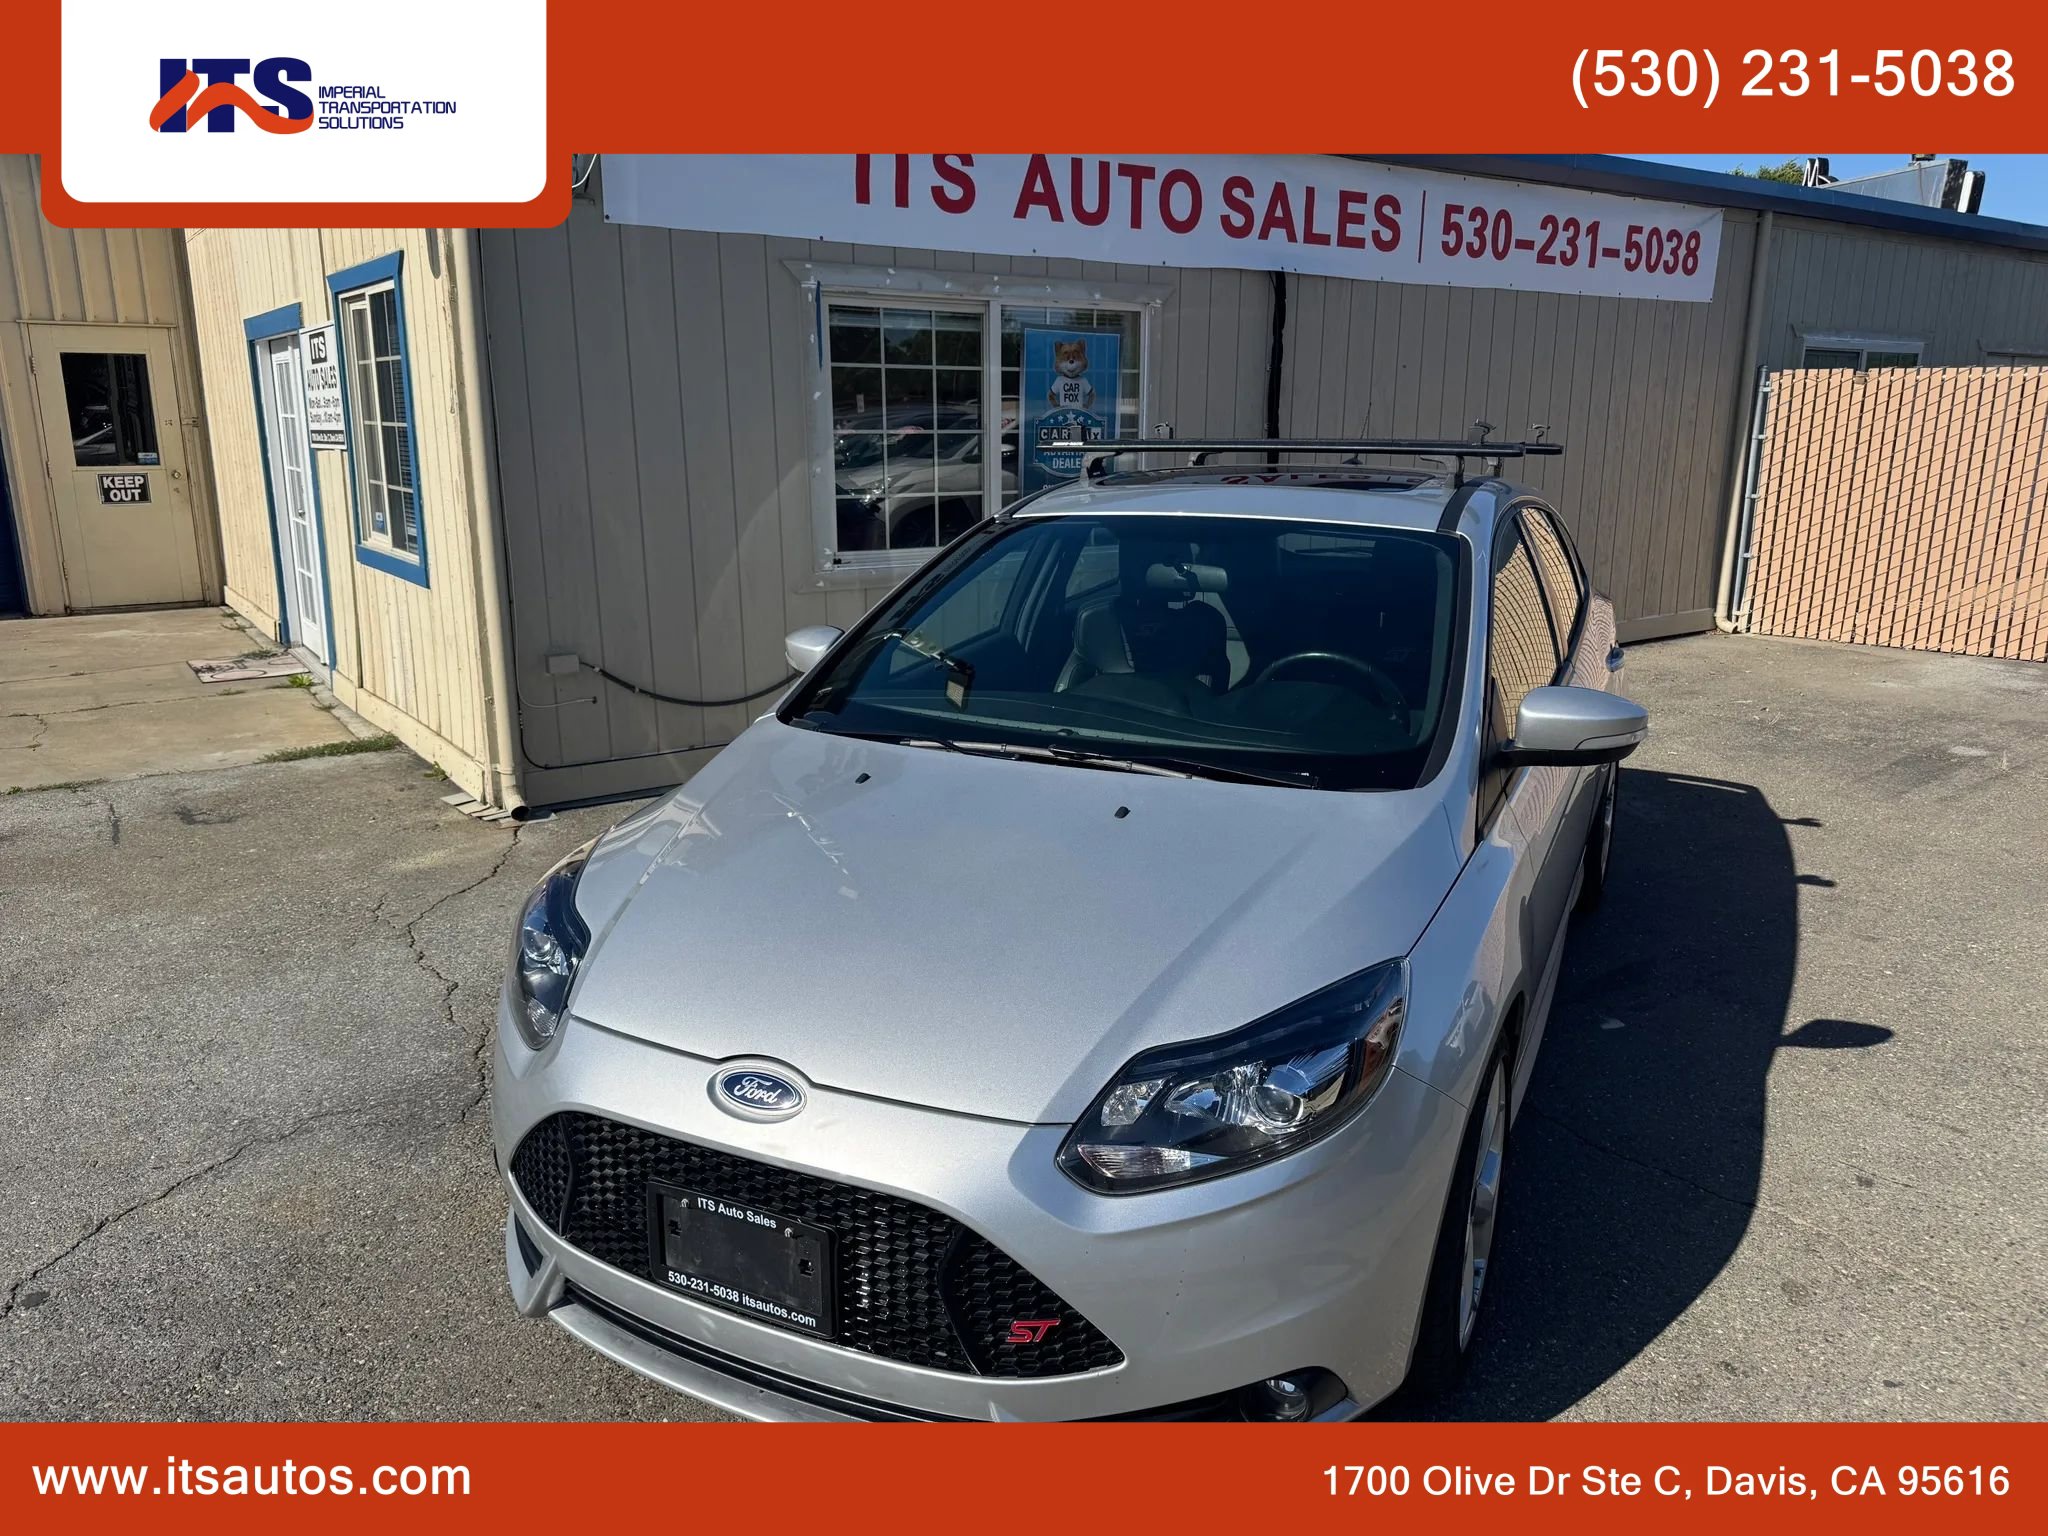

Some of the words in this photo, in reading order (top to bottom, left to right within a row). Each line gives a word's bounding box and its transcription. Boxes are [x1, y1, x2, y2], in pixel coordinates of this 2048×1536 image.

[1013, 154, 1203, 235] AUTO
[1219, 175, 1402, 252] SALES
[1441, 203, 1701, 276] 530-231-5038
[310, 335, 326, 360] ITS
[320, 365, 338, 390] SALES
[1063, 383, 1080, 393] CAR
[1064, 393, 1079, 402] FOX
[1052, 457, 1082, 469] DEALE
[102, 476, 144, 488] KEEP
[110, 489, 141, 501] OUT
[733, 1076, 782, 1104] Ford
[697, 1197, 716, 1212] ITS
[718, 1203, 744, 1219] Auto
[746, 1210, 777, 1229] Sales
[667, 1270, 740, 1302] 530-231-5038
[742, 1293, 816, 1327] itsautos.com
[1006, 1319, 1061, 1343] ST
